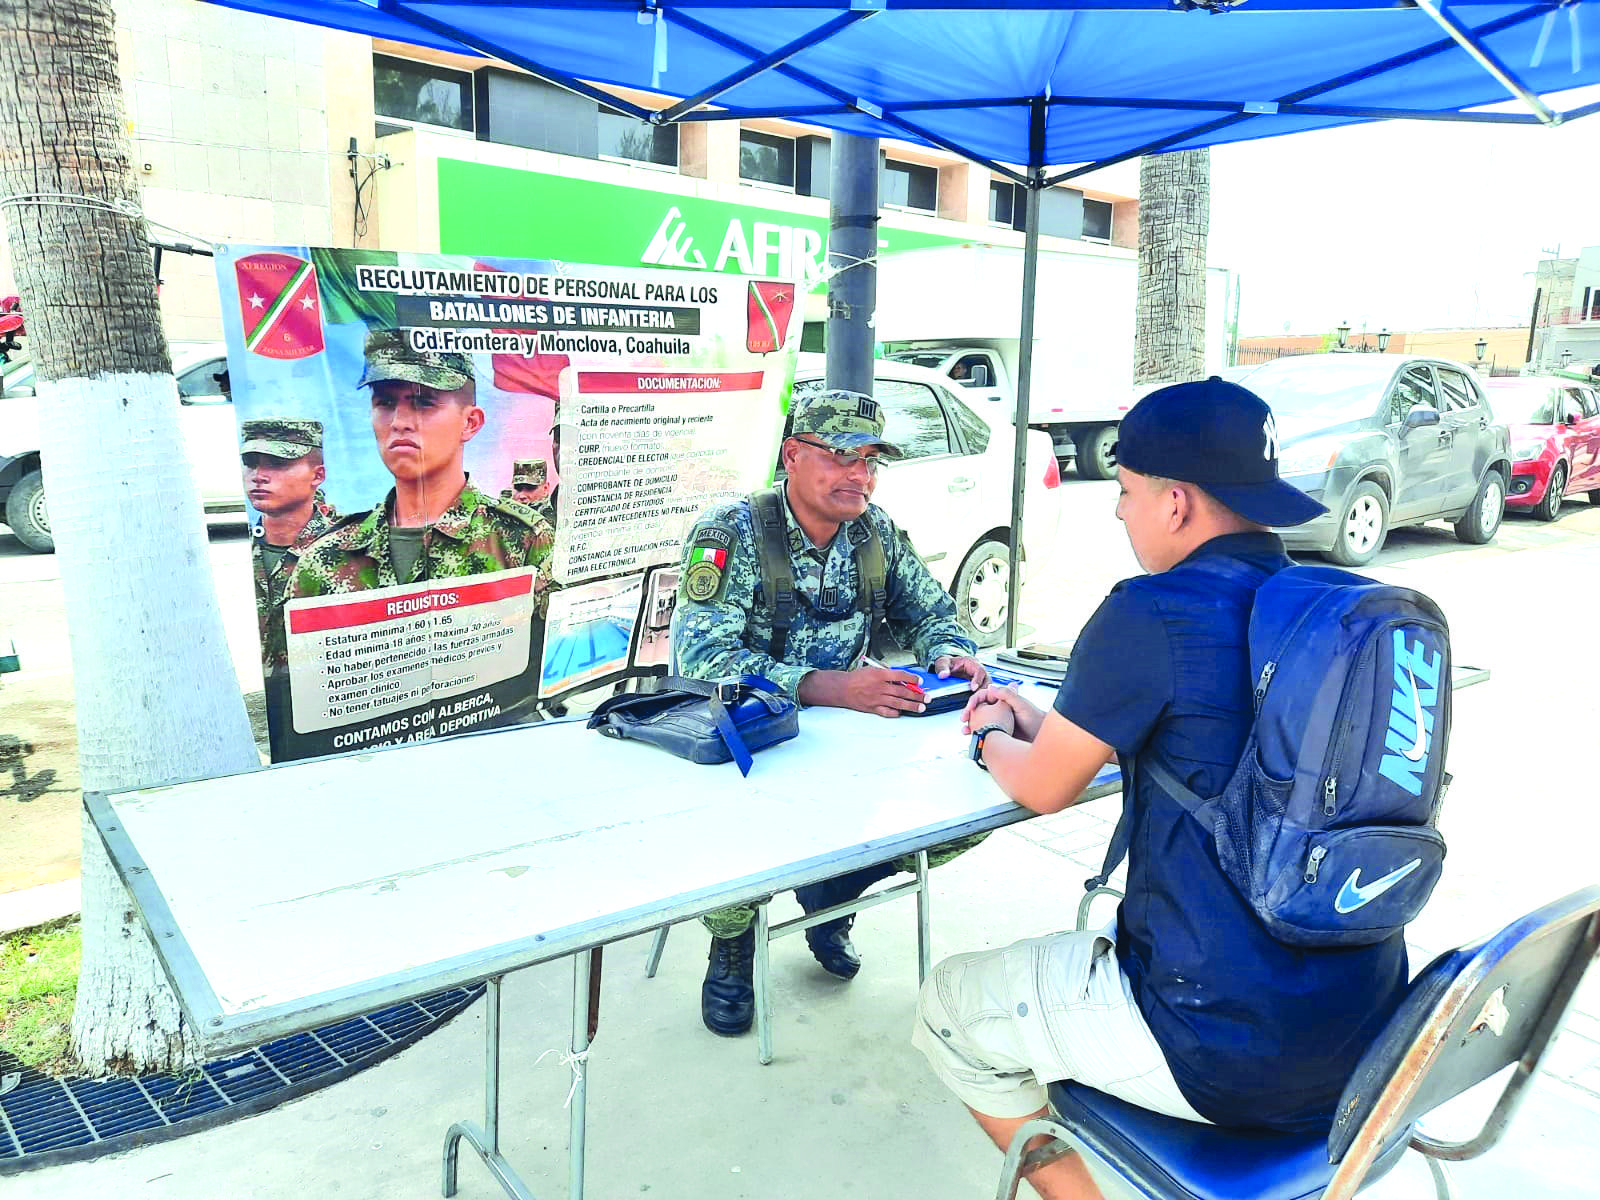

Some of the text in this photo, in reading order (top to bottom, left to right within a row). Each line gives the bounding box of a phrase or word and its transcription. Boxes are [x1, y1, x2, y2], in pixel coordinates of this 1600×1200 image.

[714, 218, 830, 280] AFIR
[359, 268, 718, 304] RECLUTAMIENTO DE PERSONAL PARA LOS
[430, 301, 676, 329] BATALLONES DE INFANTERIA
[521, 337, 534, 356] y
[541, 335, 622, 356] Monclova,
[625, 337, 690, 355] Coahuila
[637, 376, 722, 390] DOCUMENTACION:
[581, 404, 655, 414] Cartilla o Precartilla
[580, 418, 598, 427] Acta
[600, 418, 608, 426] de
[610, 417, 651, 426] nacimiento
[653, 416, 681, 426] original
[682, 418, 686, 426] y
[578, 455, 624, 466] CREDENCIAL
[626, 454, 636, 464] DE
[638, 452, 669, 463] ELECTOR
[577, 474, 678, 493] COMPROBANTE DE DOMICILIO
[574, 504, 621, 517] CERTIFICADO
[622, 502, 630, 510] DE
[632, 498, 664, 509] ESTUDIOS
[577, 486, 672, 506] CONSTANCIA DE RESIDENCIA
[573, 518, 596, 529] CARTA
[597, 517, 606, 525] DE
[608, 510, 660, 523] ANTECEDENTES
[670, 504, 699, 514] PENALES
[568, 550, 612, 565] CONSTANCIA
[613, 548, 622, 558] DE
[567, 565, 589, 577] FIRMA
[387, 592, 460, 616] REQUISITOS:
[325, 632, 368, 647] Estatura
[434, 614, 453, 626] 1.65
[326, 648, 352, 661] Edad
[392, 638, 403, 648] 18
[405, 634, 426, 646] años
[327, 665, 341, 675] No
[344, 660, 372, 672] haber
[374, 646, 426, 668] pertenecido
[434, 642, 448, 652] las
[450, 636, 480, 650] fuerzas
[482, 626, 514, 642] armadas
[327, 673, 368, 690] Aprobar
[370, 669, 384, 682] los
[386, 660, 429, 678] examenes
[468, 644, 496, 659] previos
[498, 642, 502, 651] y
[328, 690, 368, 704] examen
[329, 708, 343, 718] No
[346, 702, 370, 714] tener
[374, 692, 408, 707] tatuajes
[410, 687, 419, 697] ni
[333, 718, 410, 748] CONTAMOS
[412, 708, 434, 728] CON
[438, 692, 494, 719] ALBERCA,
[394, 736, 405, 745] Y
[407, 725, 436, 744] AREA
[440, 704, 501, 735] DEPORTIVA
[1378, 629, 1442, 797] NIKE
